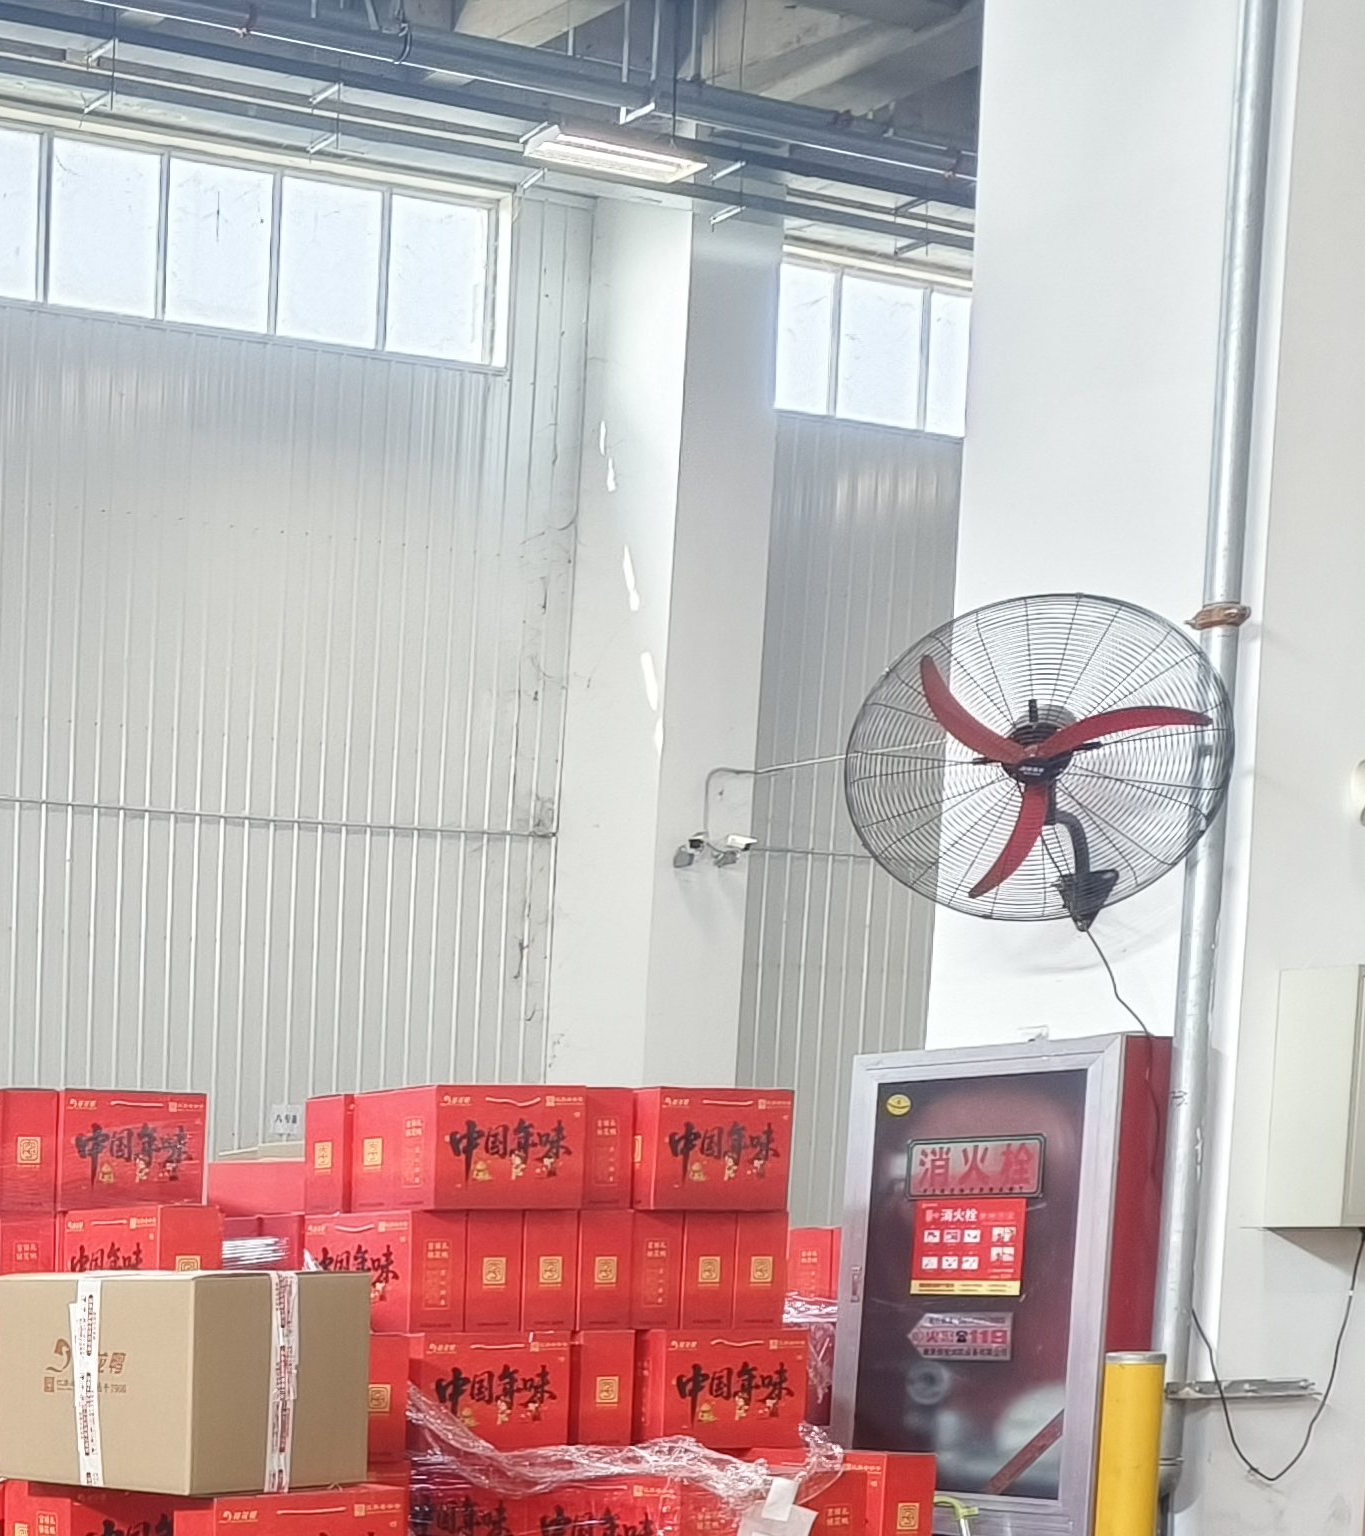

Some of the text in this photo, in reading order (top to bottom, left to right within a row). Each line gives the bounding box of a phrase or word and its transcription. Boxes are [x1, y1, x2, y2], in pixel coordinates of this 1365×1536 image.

[75, 1123, 193, 1191] 中国年味
[449, 1119, 572, 1191] 中国年味
[669, 1121, 780, 1187] 中国年味
[919, 1143, 1034, 1187] 消火栓
[940, 1208, 978, 1222] 消火栓
[969, 1330, 1008, 1345] 119
[435, 1364, 557, 1421] 中国年味
[676, 1362, 794, 1431] 中国年味
